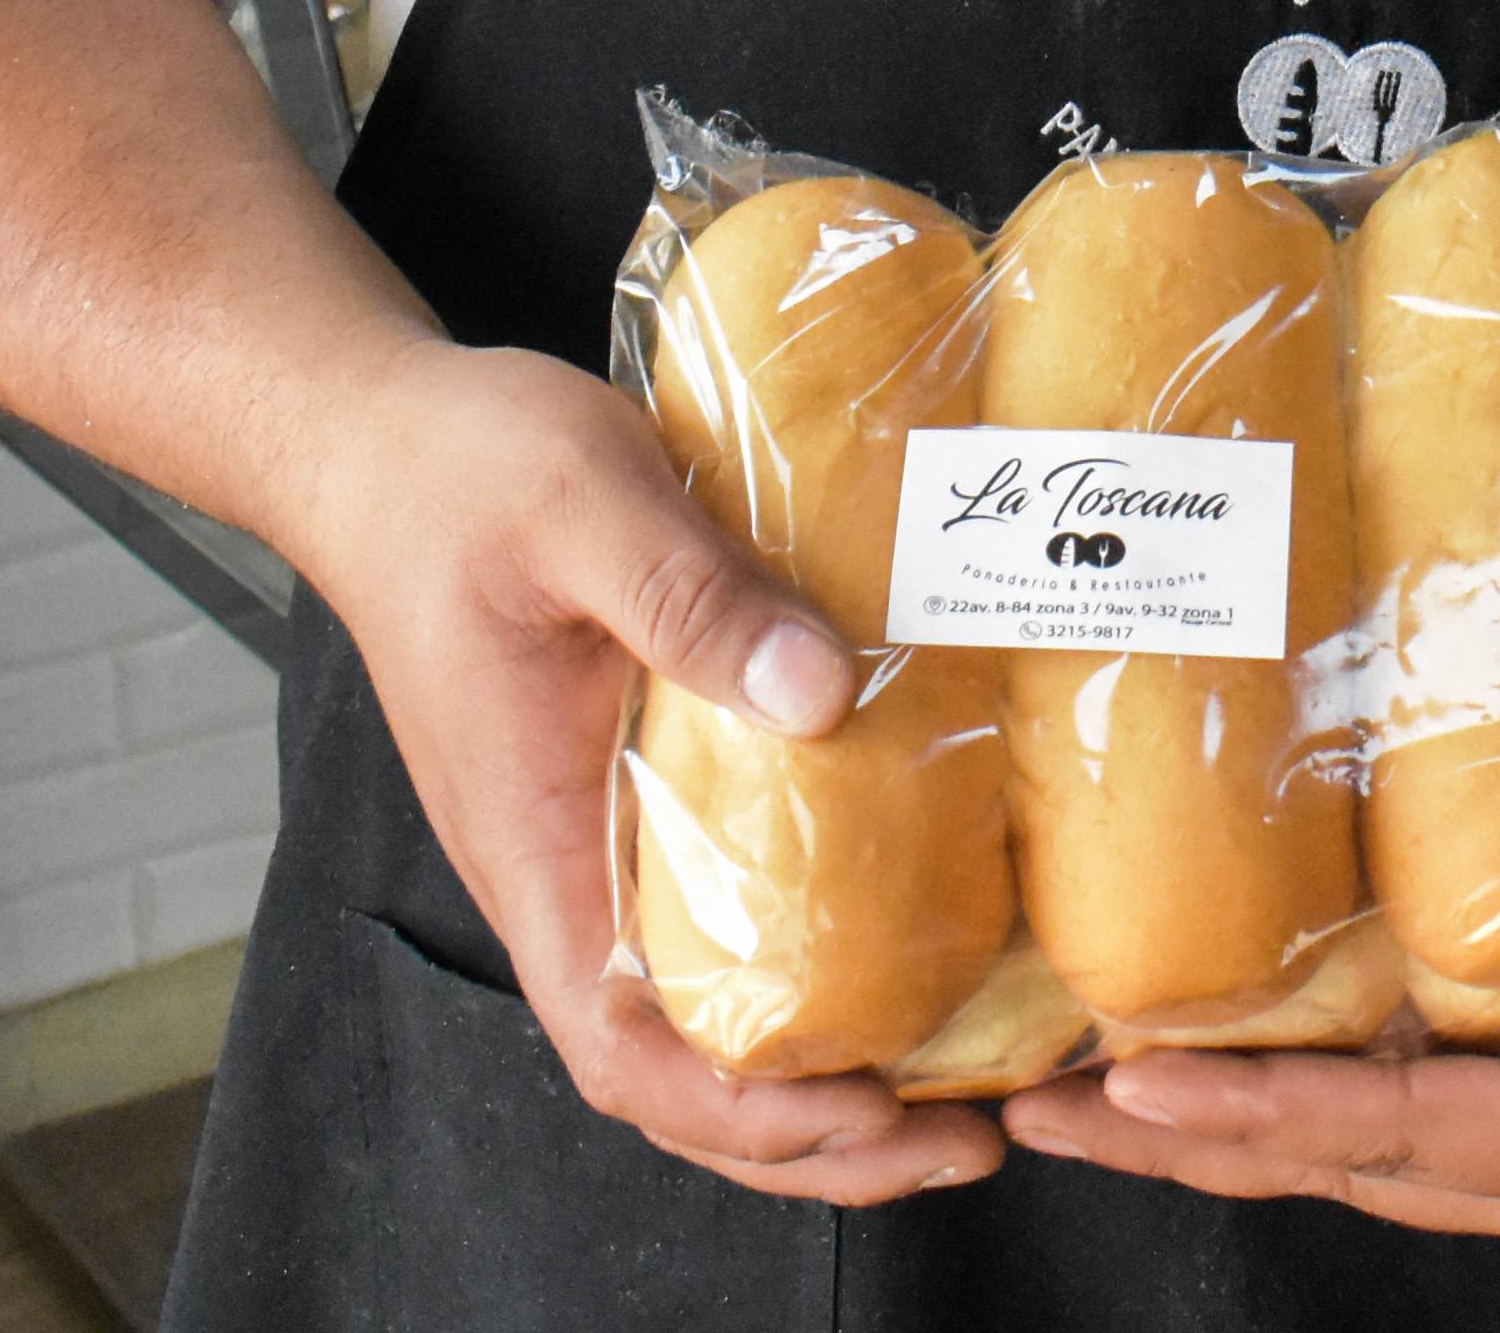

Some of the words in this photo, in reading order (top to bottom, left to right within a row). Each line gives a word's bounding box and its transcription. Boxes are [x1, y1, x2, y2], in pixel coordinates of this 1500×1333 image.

[941, 457, 1034, 533] La
[1041, 457, 1236, 529] Toscana
[960, 563, 1058, 591] Panaderia
[1069, 579, 1078, 592] &
[1090, 572, 1207, 592] Restaurante
[949, 600, 991, 614] 22av.
[995, 600, 1032, 614] 8-84
[1035, 603, 1075, 615] zona
[1080, 602, 1089, 615] 3
[1092, 602, 1101, 616] /
[1104, 603, 1138, 617] 9av.
[1141, 604, 1178, 618] 9-32
[1181, 607, 1221, 619] zona
[1227, 606, 1233, 620] 1
[1046, 624, 1134, 640] 3215-9817
